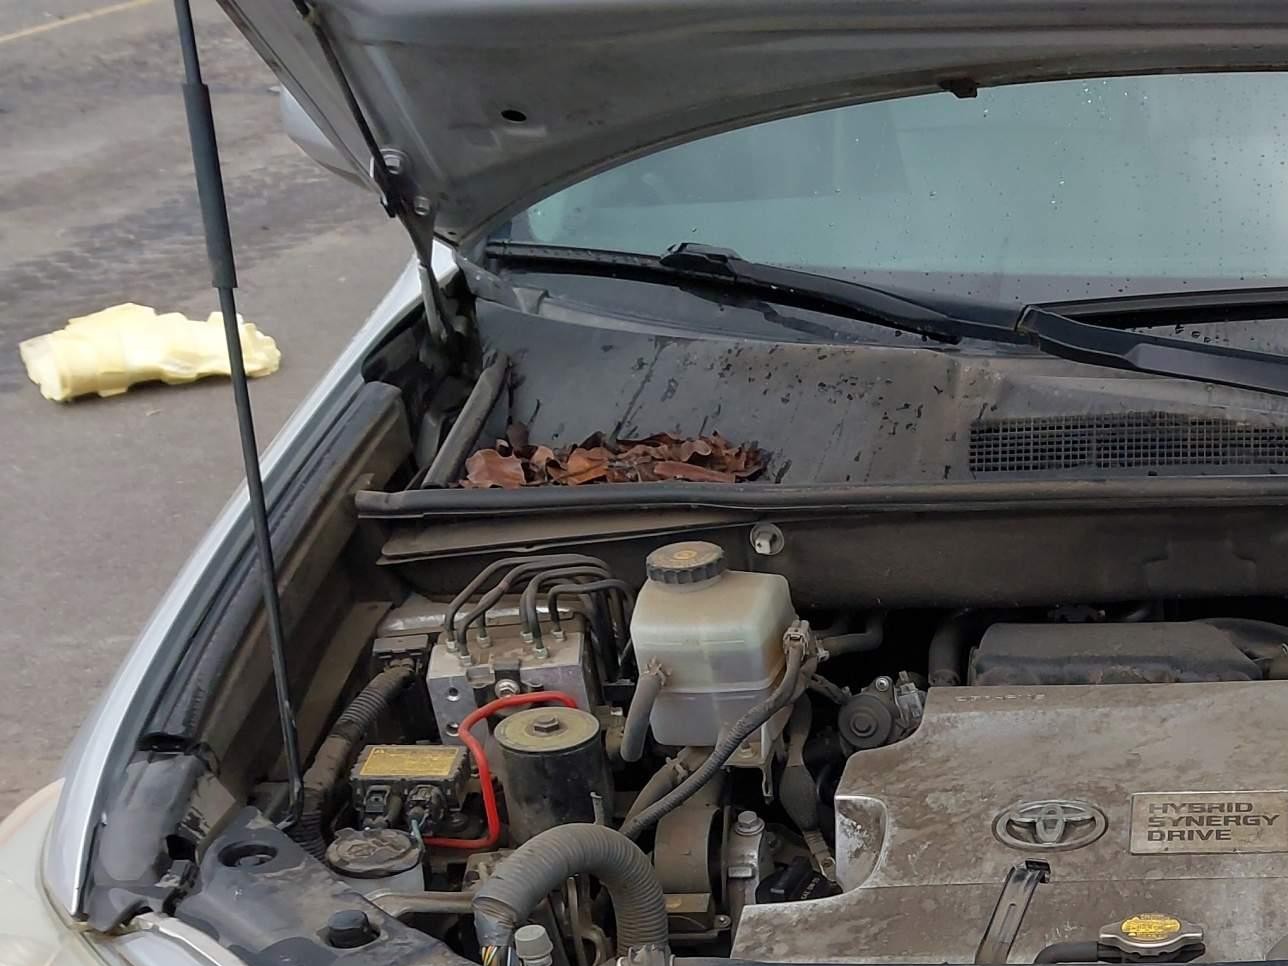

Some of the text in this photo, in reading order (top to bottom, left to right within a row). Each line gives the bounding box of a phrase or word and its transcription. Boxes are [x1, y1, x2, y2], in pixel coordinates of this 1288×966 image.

[1149, 802, 1253, 814] HYBRID
[1148, 814, 1280, 827] SYNERGY
[1147, 829, 1232, 841] DRIVE
